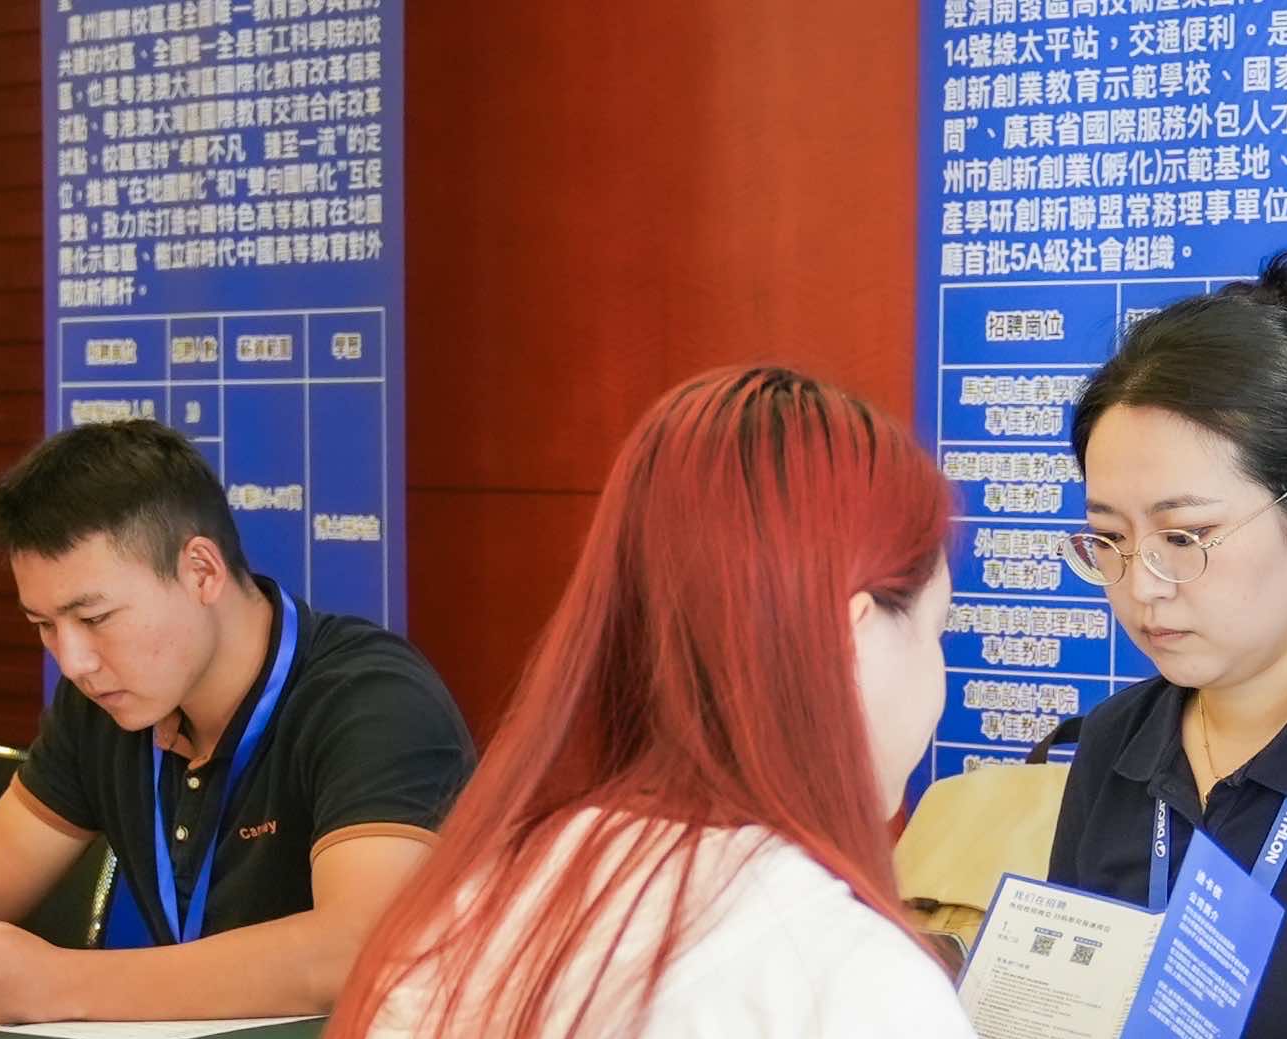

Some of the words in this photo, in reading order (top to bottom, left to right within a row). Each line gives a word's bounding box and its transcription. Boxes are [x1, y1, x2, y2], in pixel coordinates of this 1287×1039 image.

[941, 237, 1193, 277] 廳首批5A級社會組織。
[985, 311, 1065, 342] 招聘崗位
[985, 406, 1063, 436] 專任教師
[984, 484, 1062, 513] 專任教師
[983, 560, 1061, 590] 專任教師
[982, 635, 1061, 668] 專任教師
